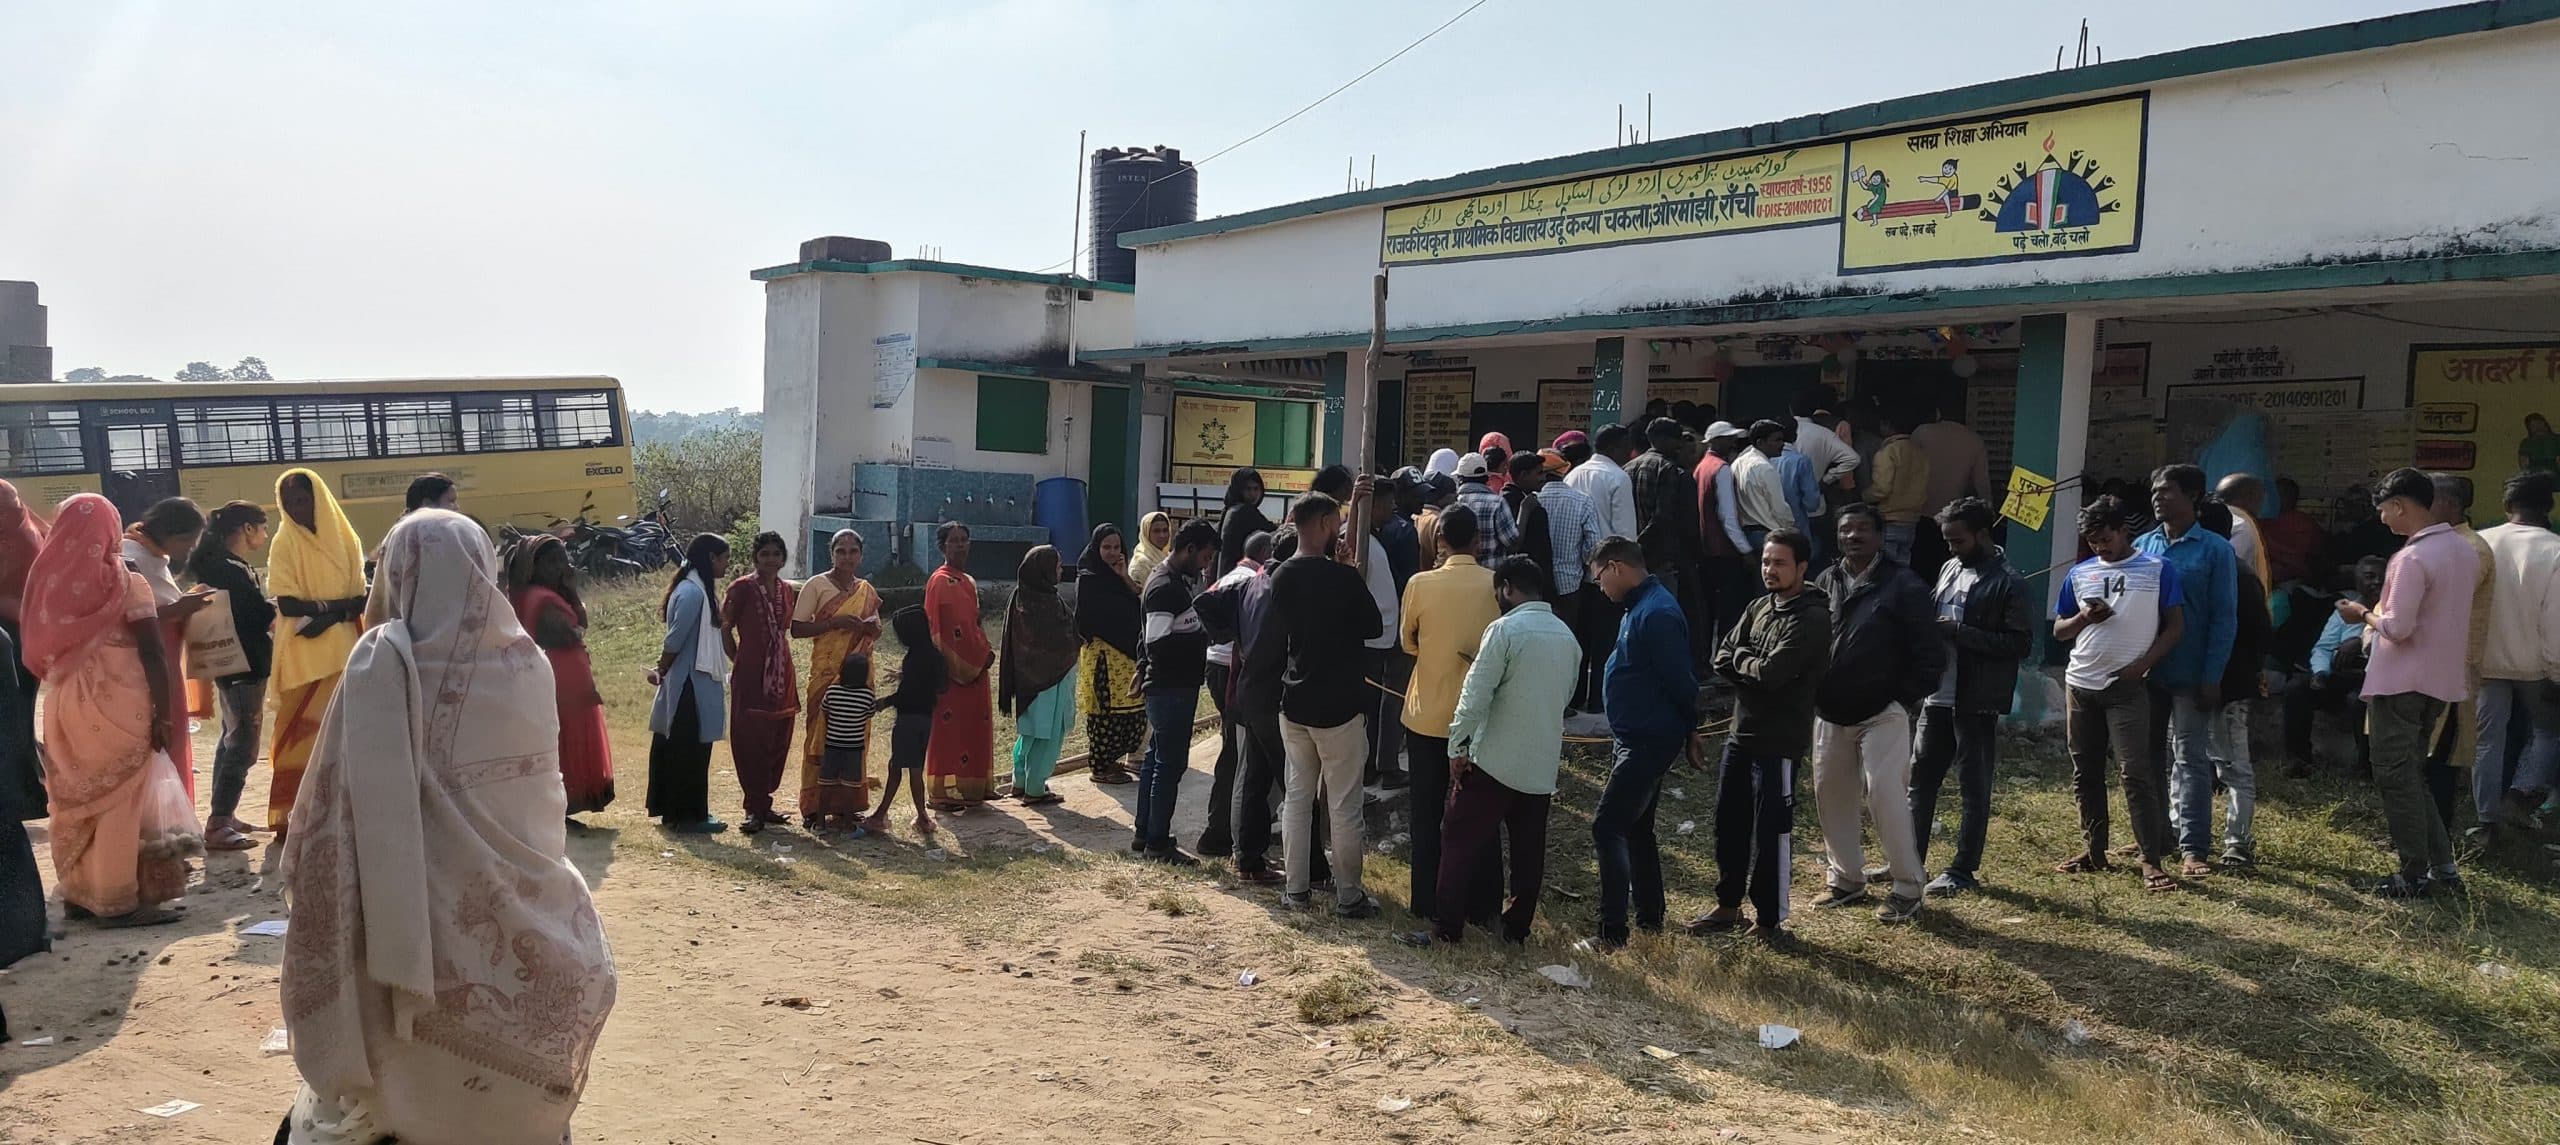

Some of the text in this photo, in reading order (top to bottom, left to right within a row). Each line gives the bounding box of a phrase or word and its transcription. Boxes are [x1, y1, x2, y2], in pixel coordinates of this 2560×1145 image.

[1907, 121, 2029, 152] समग्र शिक्षा अभियान
[1636, 169, 1662, 194] اردو
[1387, 226, 1451, 257] राजकीयकृत
[1451, 219, 1499, 249] प्राथमिक
[1499, 216, 1547, 244] विद्यालय
[1547, 206, 1567, 245] उर्दू
[1566, 208, 1603, 237] कन्या
[1719, 182, 1759, 221] राँची
[1885, 227, 1898, 237] सब
[1912, 224, 1925, 237] सब
[2069, 226, 2090, 245] चलो
[2441, 350, 2536, 384] आदर्श
[585, 466, 624, 476] EXCELO
[2103, 575, 2125, 599] 14
